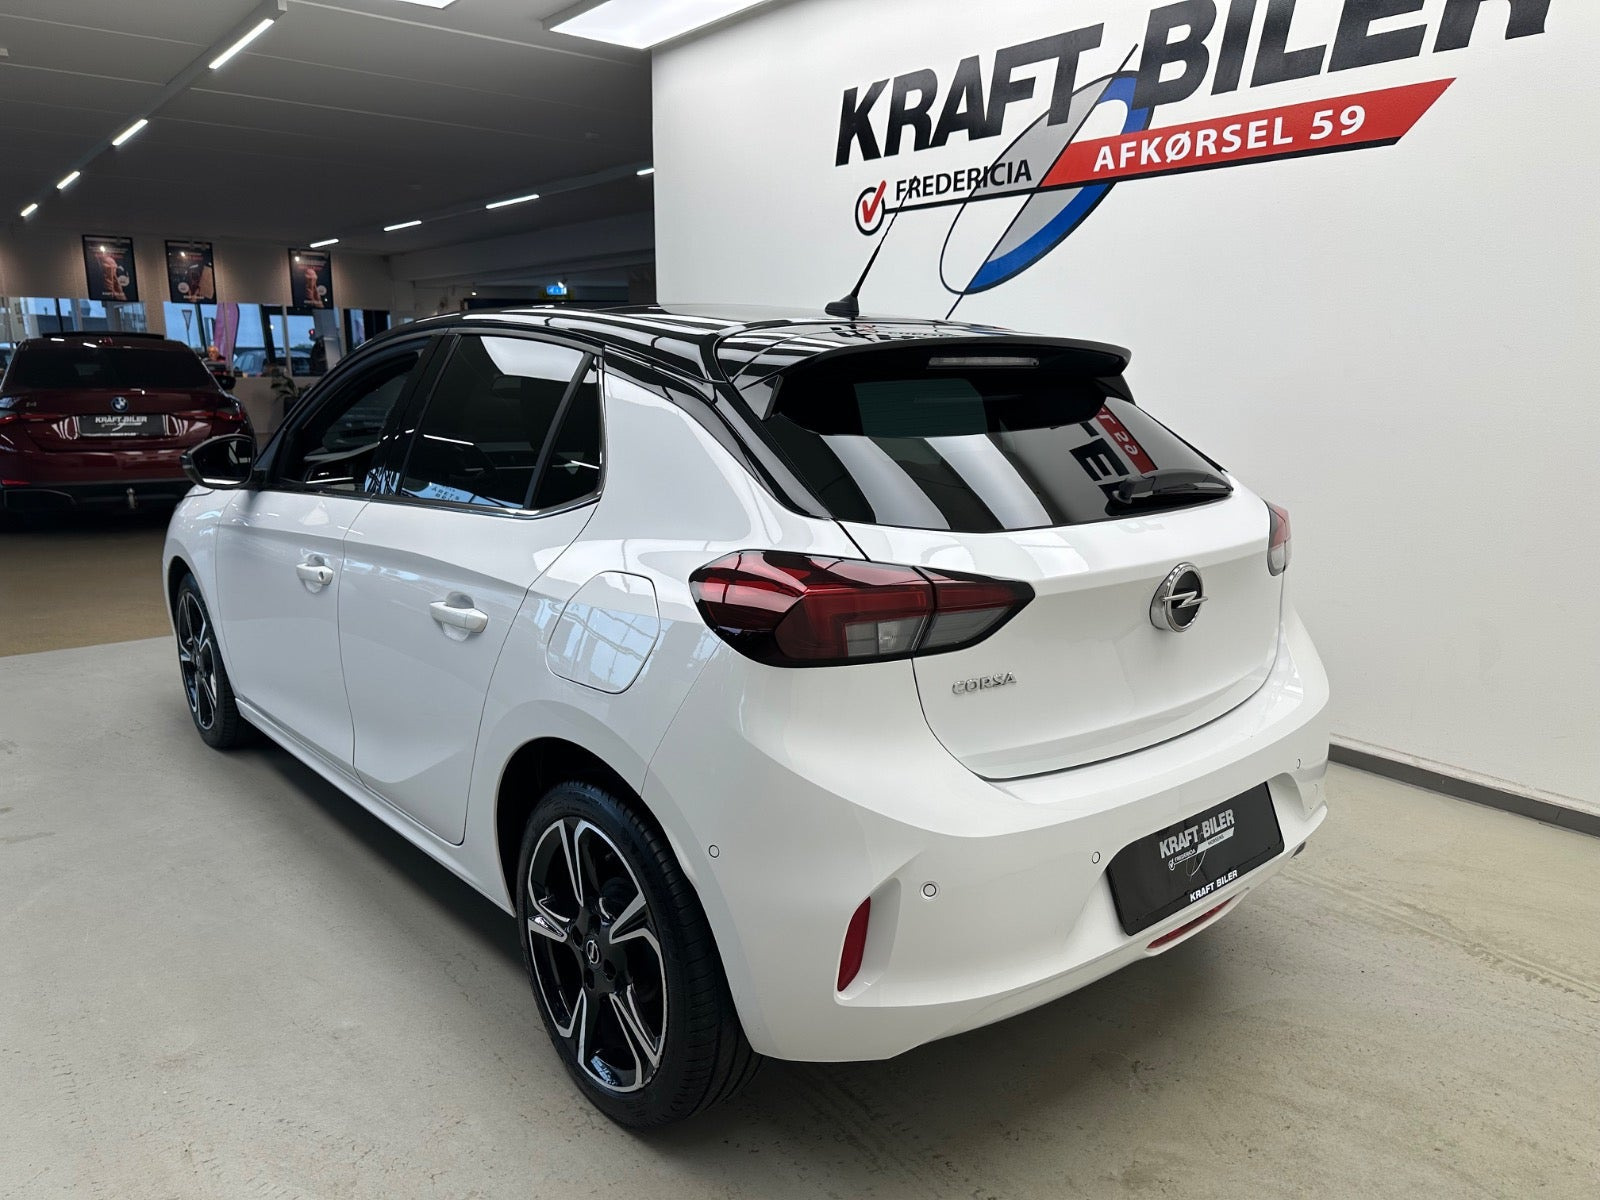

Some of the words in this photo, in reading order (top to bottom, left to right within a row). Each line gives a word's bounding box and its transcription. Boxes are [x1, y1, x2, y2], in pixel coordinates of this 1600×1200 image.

[835, 22, 1104, 167] KRAFT
[1093, 116, 1294, 172] AFKØRSEL
[1308, 104, 1366, 141] 59
[895, 159, 1032, 201] FREDERICIA
[952, 671, 1017, 695] CORSA
[1159, 825, 1199, 859] KRAFT
[1201, 808, 1235, 839] BILER
[1190, 882, 1215, 903] KRAFT
[1216, 869, 1238, 888] BILER
